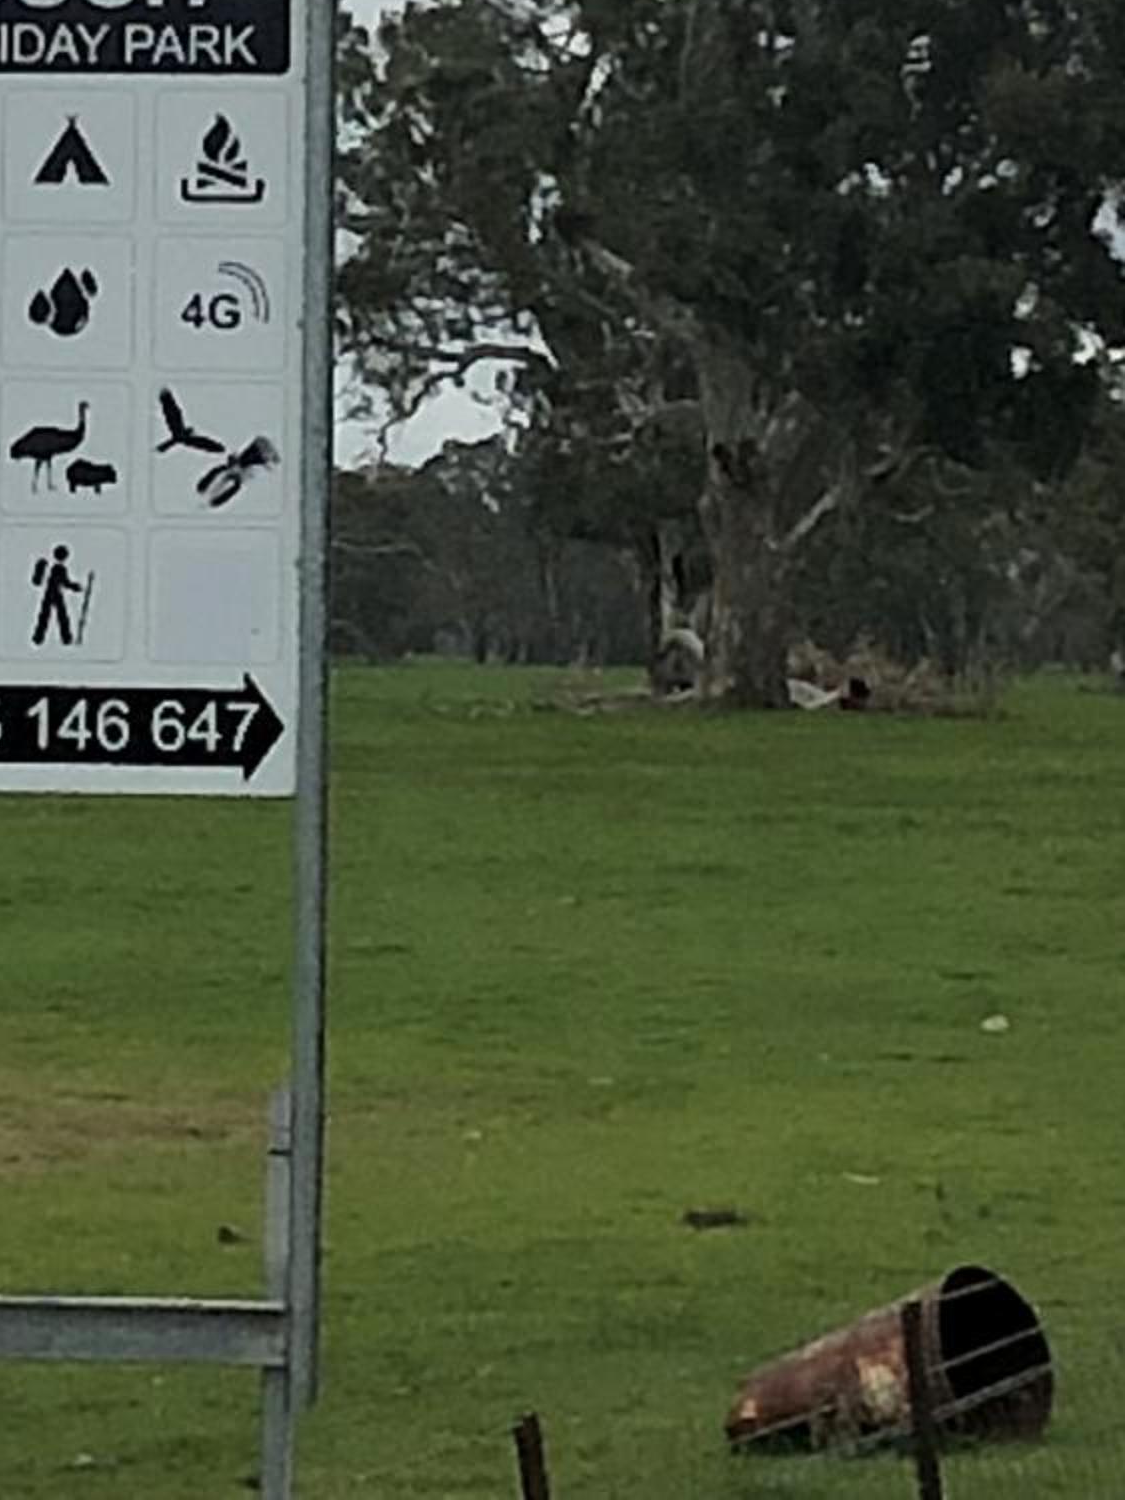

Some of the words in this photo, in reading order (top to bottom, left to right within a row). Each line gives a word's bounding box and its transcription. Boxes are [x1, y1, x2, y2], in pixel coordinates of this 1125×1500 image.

[124, 23, 257, 65] PARK
[181, 293, 241, 329] 4G
[27, 696, 130, 752] 146
[150, 699, 260, 753] 647
